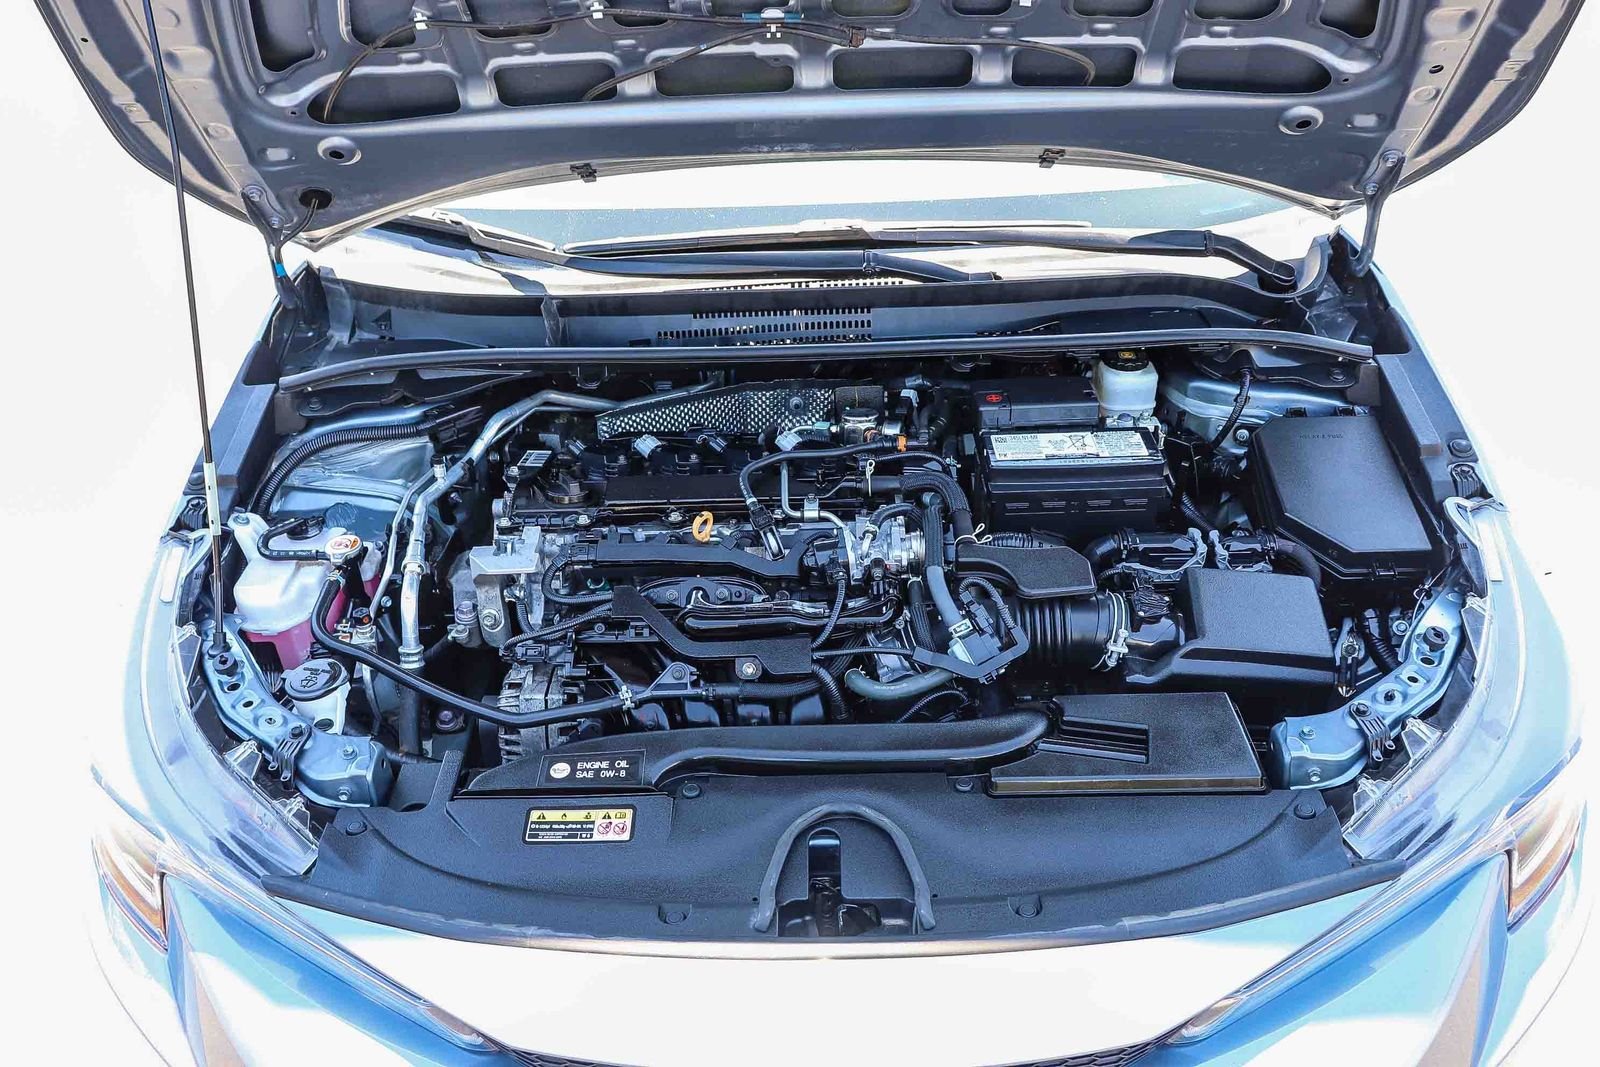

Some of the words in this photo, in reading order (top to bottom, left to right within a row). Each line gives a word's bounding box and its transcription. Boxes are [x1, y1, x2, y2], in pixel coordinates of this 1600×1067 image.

[577, 761, 610, 769] ENGINE
[614, 760, 630, 768] OIL
[575, 770, 595, 778] SAE
[600, 769, 626, 778] 0W-8
